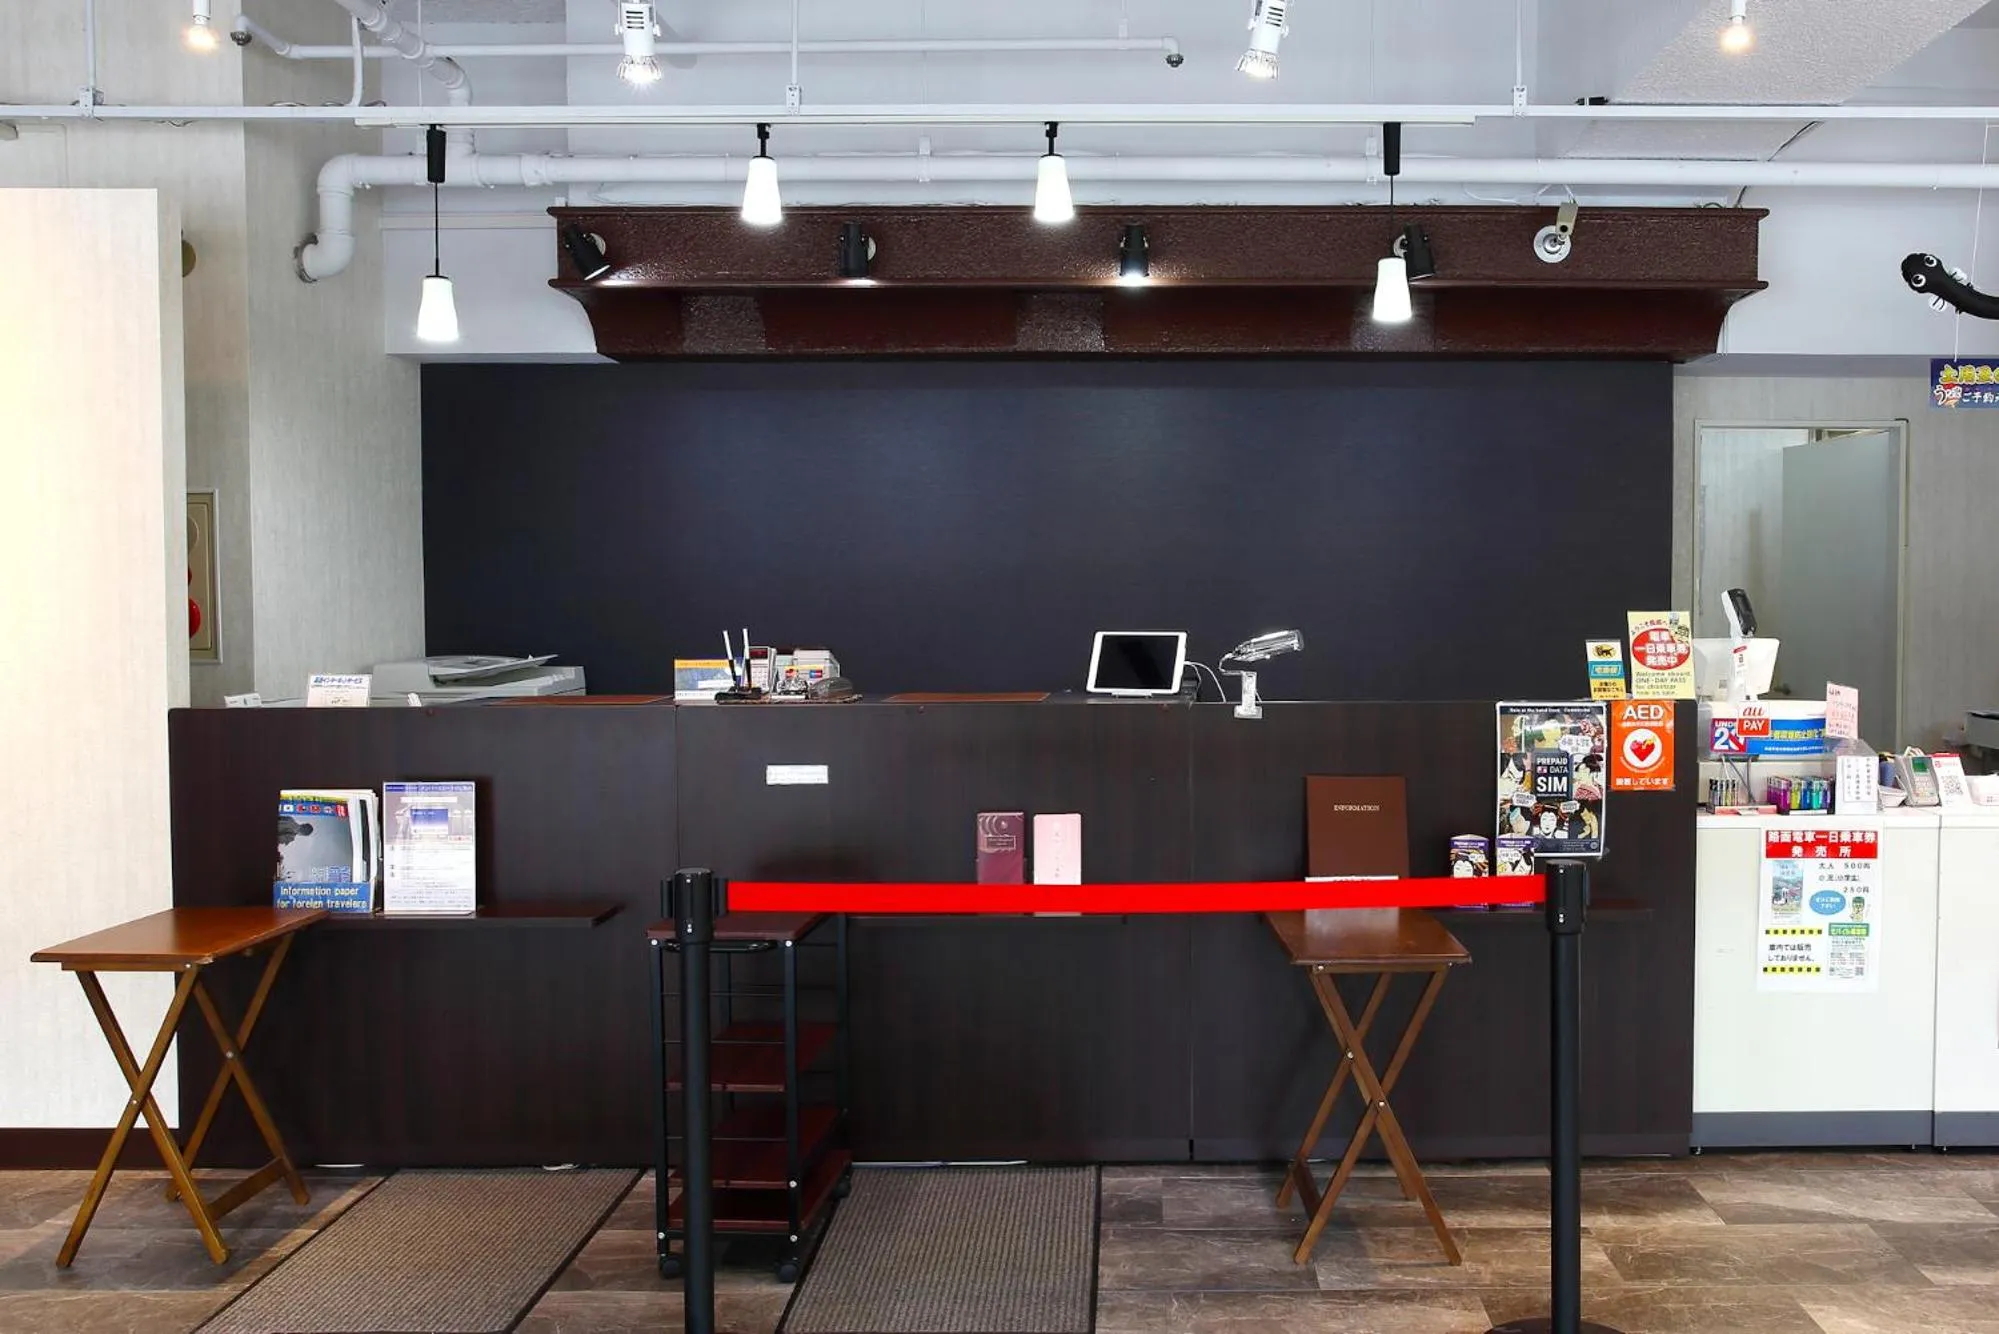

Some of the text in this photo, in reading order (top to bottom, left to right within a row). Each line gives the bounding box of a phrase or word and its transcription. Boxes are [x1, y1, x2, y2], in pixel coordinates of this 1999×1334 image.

[1623, 704, 1664, 720] AED
[1744, 720, 1764, 730] PAY
[1537, 757, 1568, 765] PREPAID
[1536, 776, 1568, 792] SIM
[1767, 830, 1877, 843] 路面電車一日乗車券
[280, 886, 359, 897] Information paper
[277, 898, 368, 910] for foreign travelers
